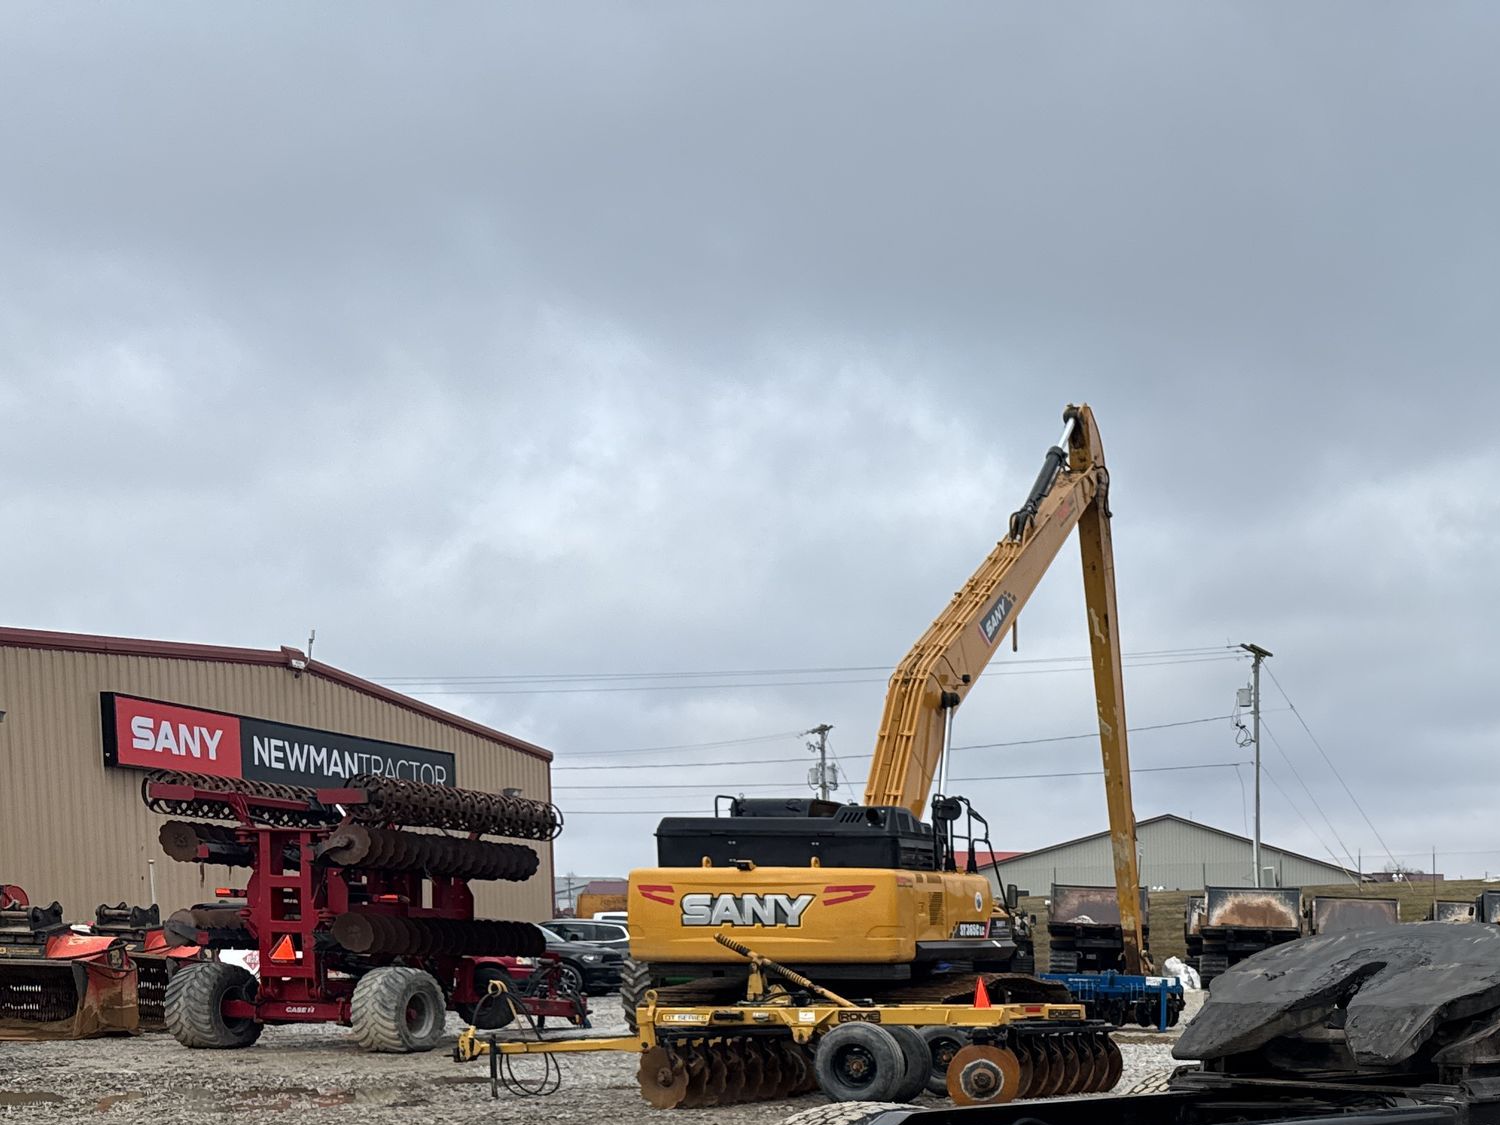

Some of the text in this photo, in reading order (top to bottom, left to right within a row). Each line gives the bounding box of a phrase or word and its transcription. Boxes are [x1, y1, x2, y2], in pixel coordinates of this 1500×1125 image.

[985, 598, 1006, 638] SANY
[130, 715, 224, 761] SANY
[680, 892, 817, 928] SANY
[839, 1011, 881, 1022] ROME
